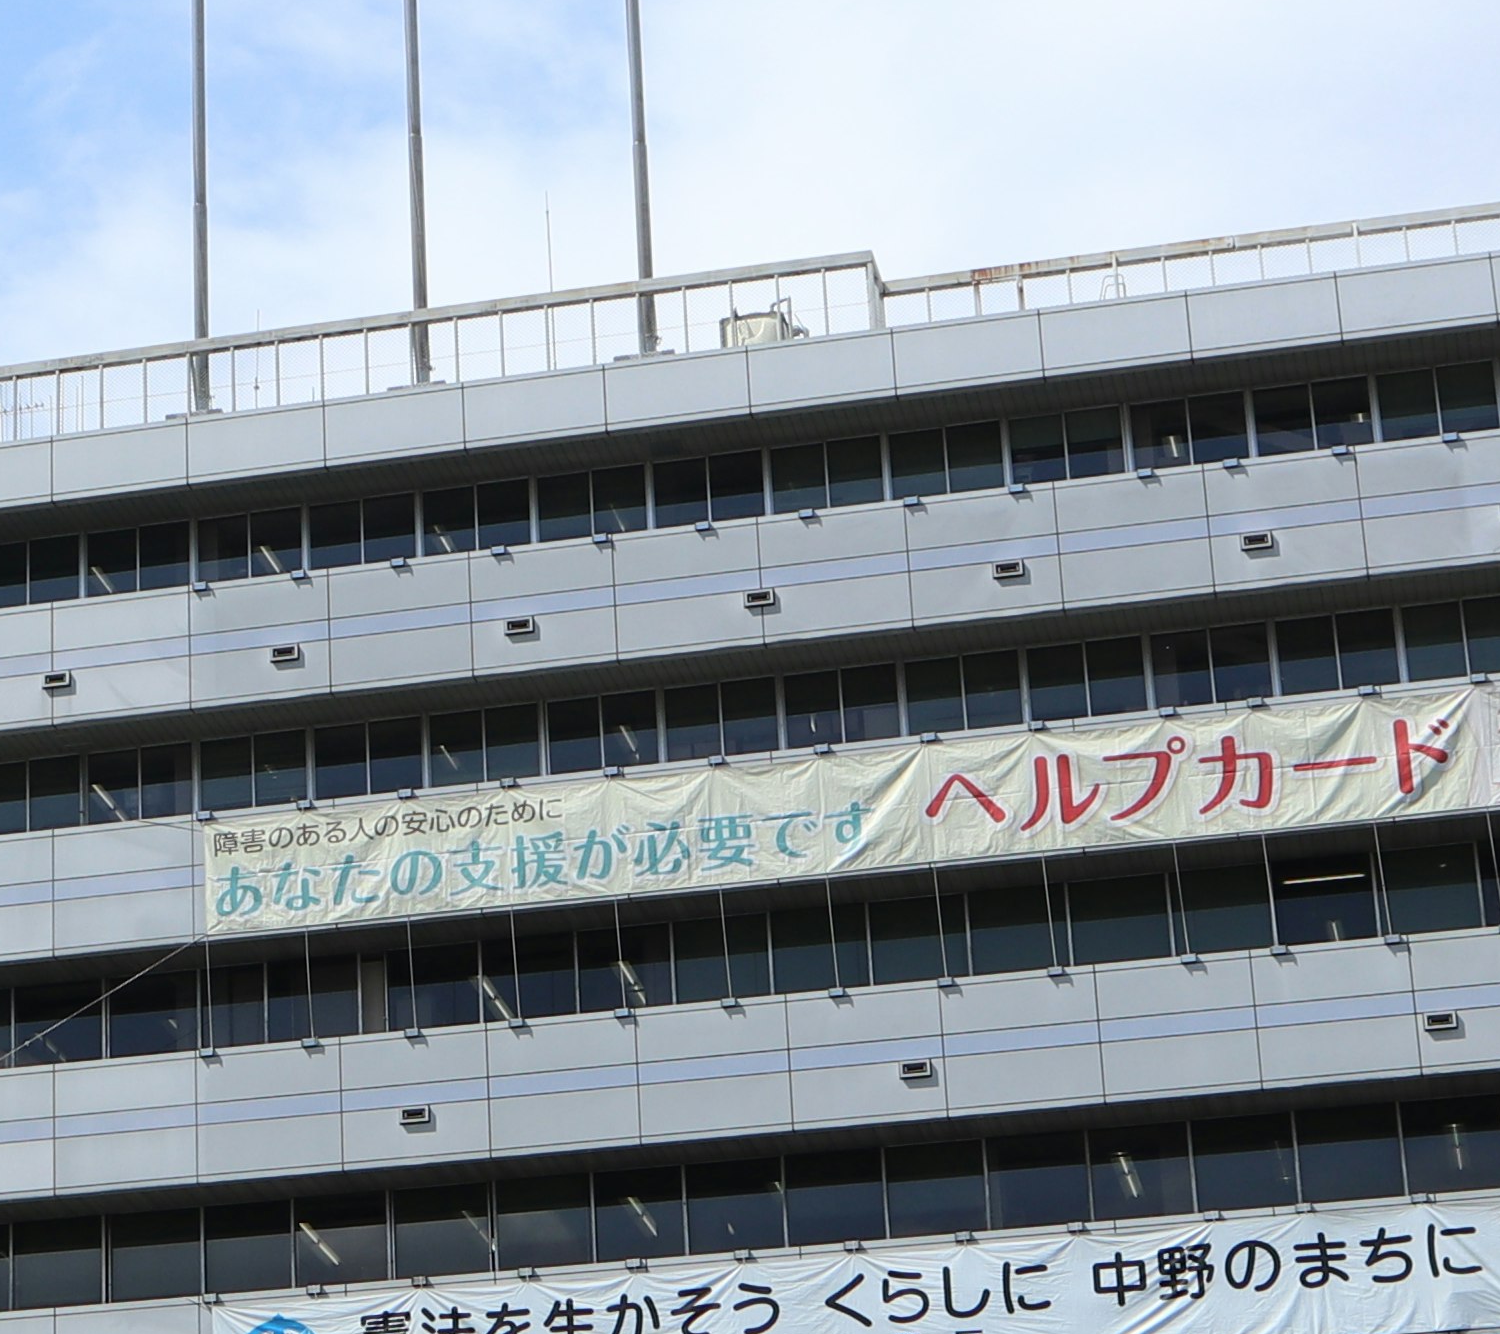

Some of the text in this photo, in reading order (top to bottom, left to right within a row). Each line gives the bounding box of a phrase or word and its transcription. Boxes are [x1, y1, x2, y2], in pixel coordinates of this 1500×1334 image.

[214, 796, 563, 856] 障害のある人の安心のために
[925, 716, 1450, 832] ヘルプカード
[215, 802, 873, 918] あなたの支援が必要です
[824, 1260, 1052, 1327] くらしに
[1092, 1223, 1482, 1310] 中野のまちに
